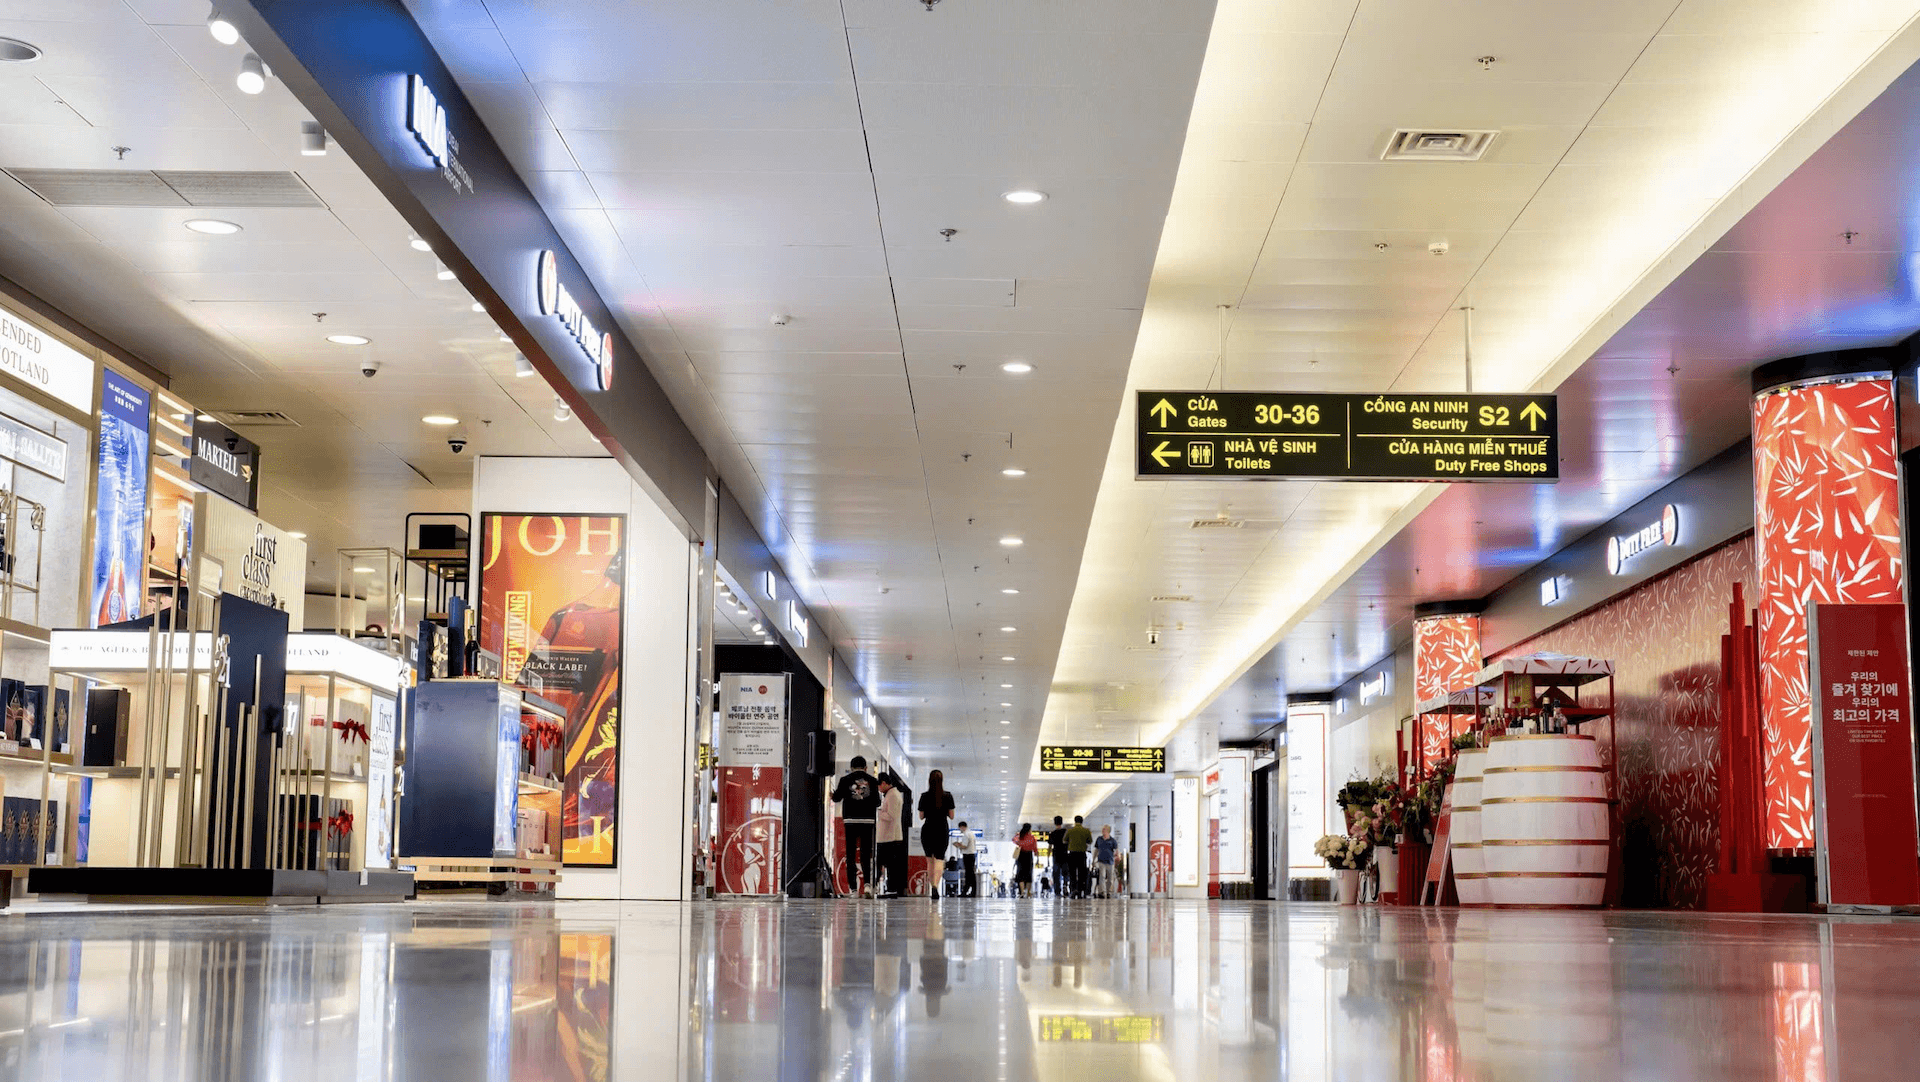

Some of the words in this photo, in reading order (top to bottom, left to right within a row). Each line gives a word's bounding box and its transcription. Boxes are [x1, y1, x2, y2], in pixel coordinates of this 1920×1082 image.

[1188, 396, 1218, 411] CỬA
[1254, 405, 1320, 424] 30-36
[1364, 396, 1406, 413] CỔNG
[1410, 401, 1430, 413] AN
[1434, 401, 1468, 413] NINH
[1479, 405, 1510, 426] S2
[1188, 416, 1227, 428] Gates
[1412, 417, 1468, 432] Security
[1225, 438, 1255, 453] NHÀ
[1259, 438, 1278, 455] VỆ
[1282, 441, 1317, 453] SINH
[1389, 438, 1420, 455] CỬA
[1423, 440, 1465, 455] HÀNG
[1468, 438, 1505, 455] MIỄN
[1508, 439, 1547, 455] THUẾ
[198, 436, 238, 477] MARTELL
[1225, 457, 1271, 469] Toilets
[1435, 459, 1466, 474] Duty
[1470, 460, 1500, 472] Free
[1504, 460, 1547, 474] Shops
[255, 523, 277, 565] first
[242, 546, 270, 588] class
[509, 594, 526, 648] WALKING
[525, 661, 556, 671] BLACK
[1851, 671, 1878, 681] 우리의
[1832, 683, 1856, 697] 즐겨
[1860, 683, 1898, 697] 찾기에
[1852, 697, 1879, 707] 우리의
[1833, 708, 1870, 722] 최고의
[1875, 708, 1899, 722] 가격
